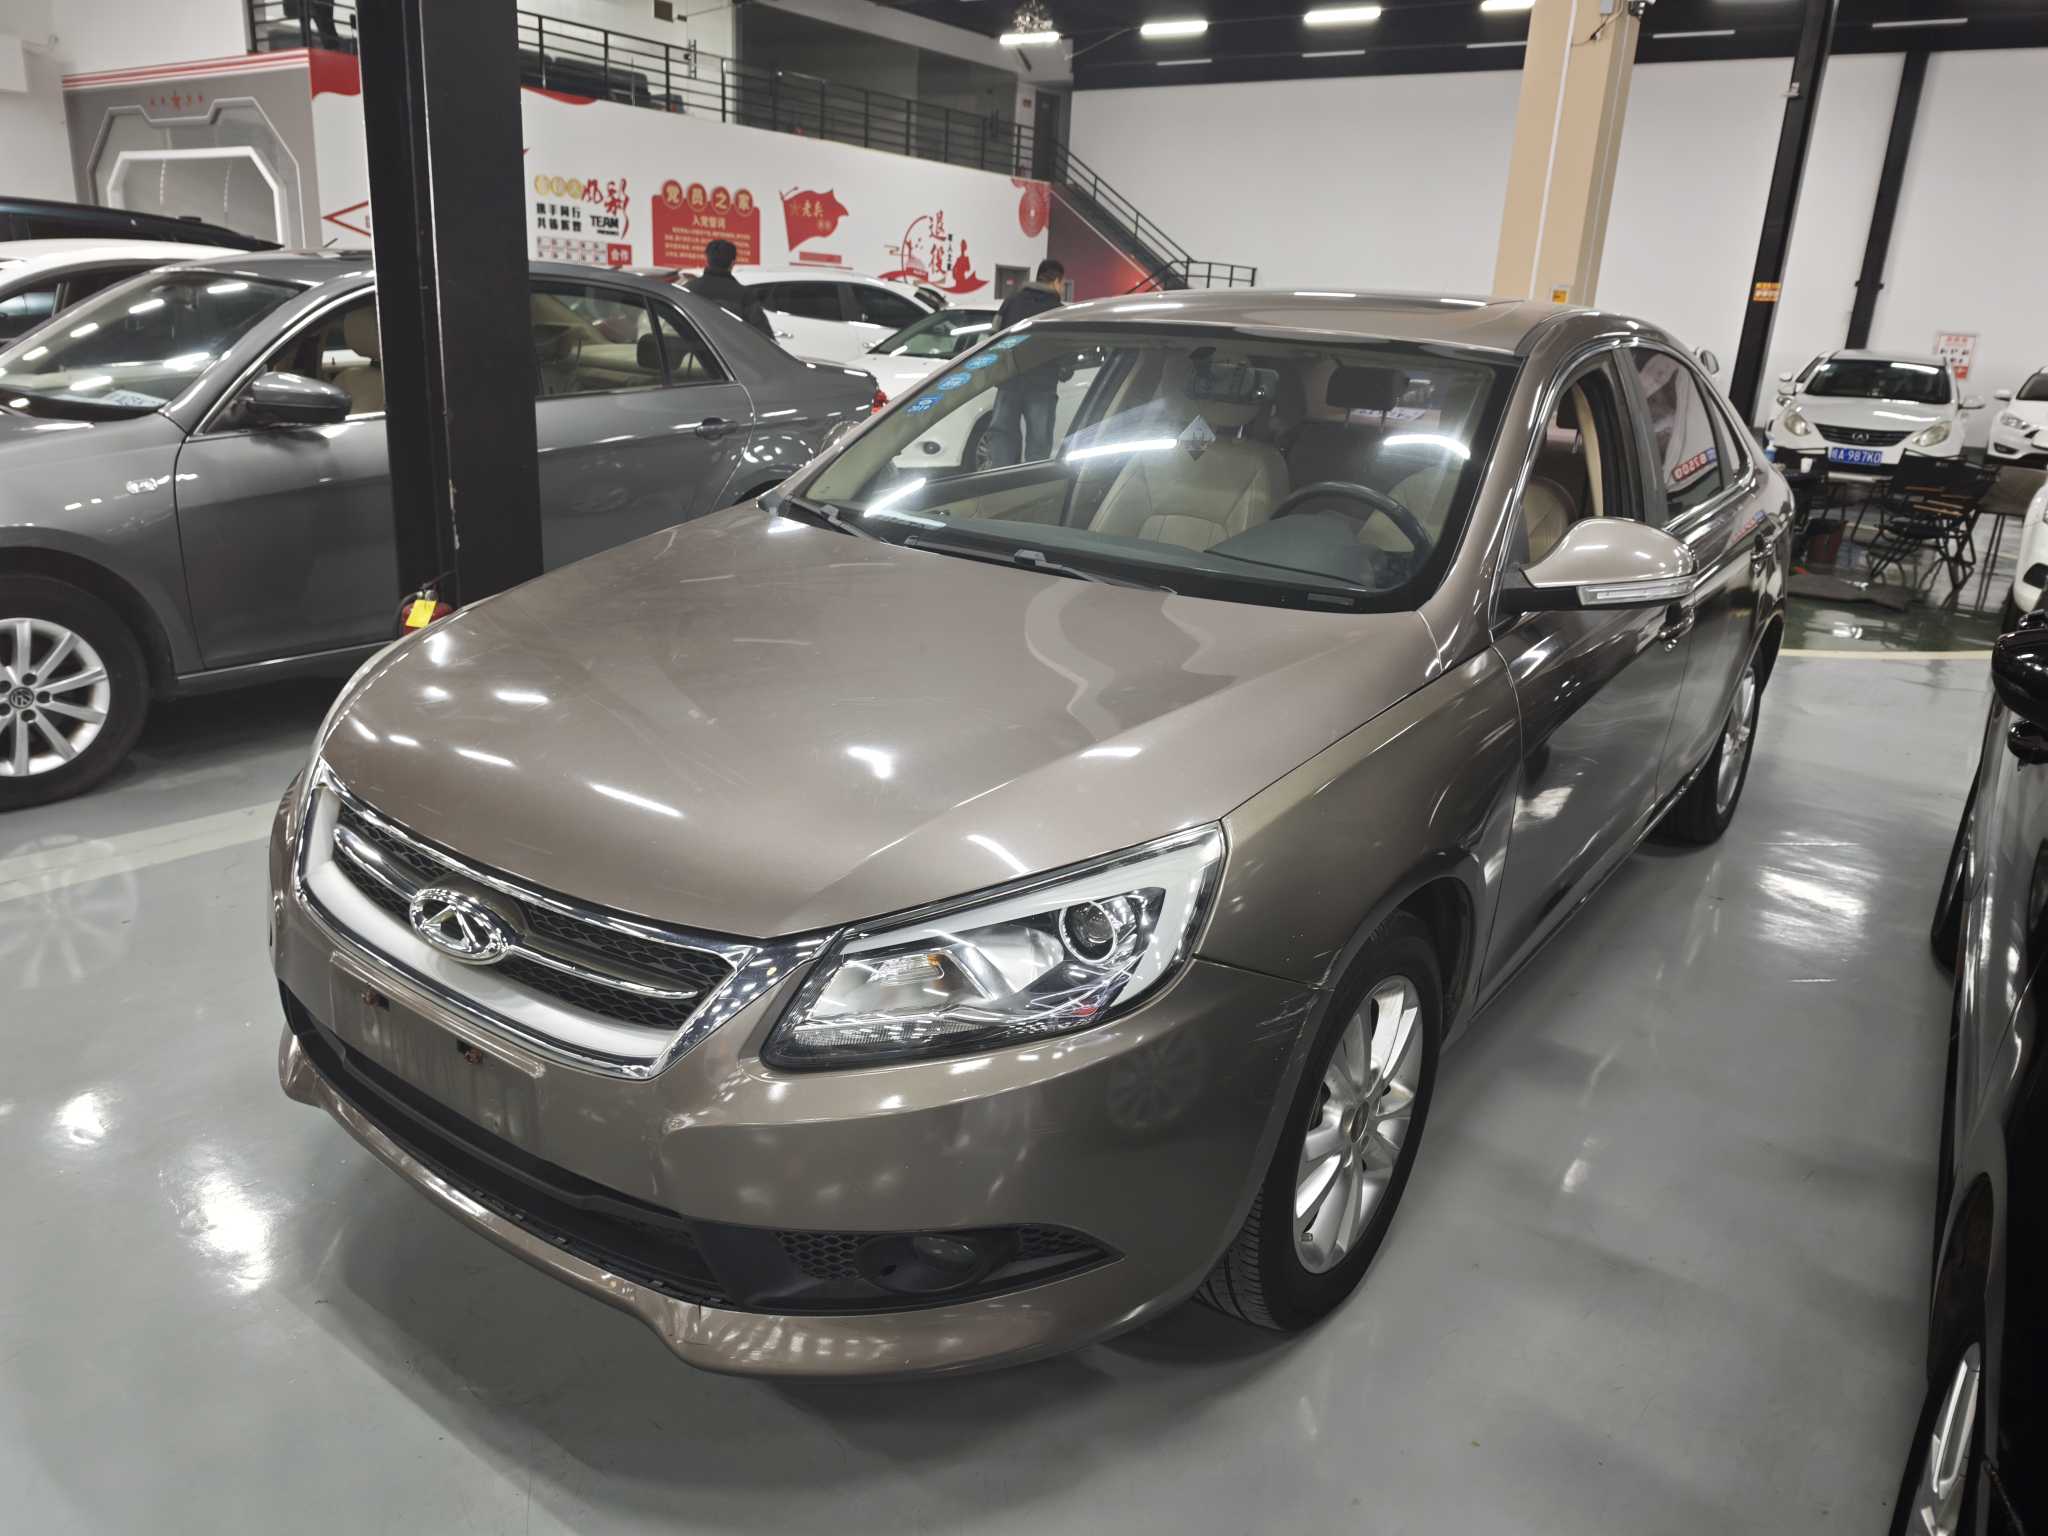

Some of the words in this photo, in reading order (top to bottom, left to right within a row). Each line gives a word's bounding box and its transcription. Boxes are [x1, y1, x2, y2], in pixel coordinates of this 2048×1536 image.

[665, 184, 750, 211] 党员之家
[590, 215, 619, 229] TEAM
